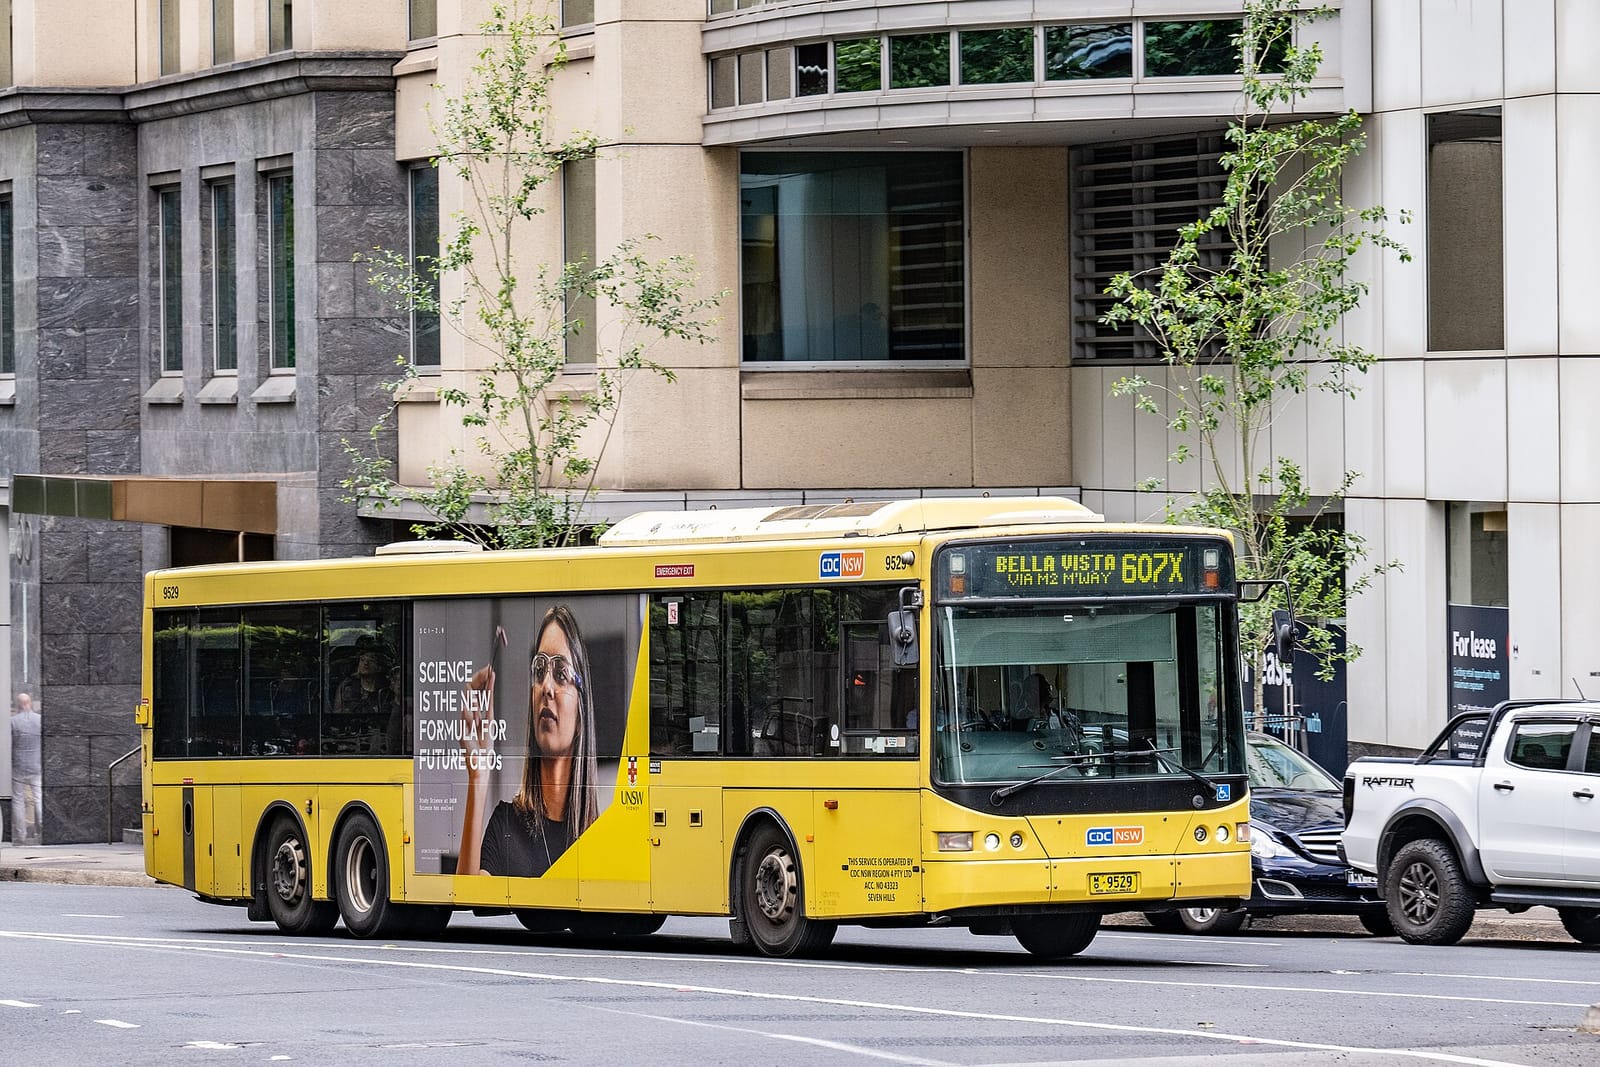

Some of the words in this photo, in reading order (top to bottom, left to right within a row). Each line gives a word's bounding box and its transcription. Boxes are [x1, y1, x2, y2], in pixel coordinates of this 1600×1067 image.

[656, 567, 683, 576] EMERGENCY
[683, 566, 694, 575] EXIT
[822, 558, 839, 572] CDC
[842, 557, 862, 572] NSW
[996, 555, 1055, 573] BELLA
[1061, 554, 1116, 571] VISTA
[1122, 552, 1184, 584] 607X
[1008, 573, 1033, 586] VIA
[1037, 572, 1059, 585] M2
[1063, 571, 1112, 585] M'WAY
[163, 586, 179, 599] 9529
[1452, 631, 1470, 657] For
[1470, 630, 1497, 659] lease
[419, 660, 473, 683] SCIENCE
[419, 690, 430, 712] IS
[433, 690, 458, 712] THE
[460, 689, 491, 712] NEW
[419, 719, 478, 741] FORMULA
[481, 719, 507, 741] FOR
[419, 748, 467, 770] FUTURE
[469, 748, 503, 771] CEOs
[1362, 777, 1415, 790] RAPTOR
[621, 790, 644, 805] UNSW
[1088, 831, 1112, 842] CDC
[1115, 830, 1140, 841] NSW
[848, 857, 858, 866] THIS
[859, 857, 877, 866] SERVICE
[878, 857, 882, 866] IS
[883, 857, 906, 866] OPERATED
[907, 857, 913, 865] BY
[850, 870, 860, 878] CDC
[861, 870, 871, 878] NSW
[903, 869, 912, 877] LTD
[1107, 875, 1133, 889] 9529
[867, 893, 882, 901] SEVEN
[883, 893, 895, 901] HILLS
